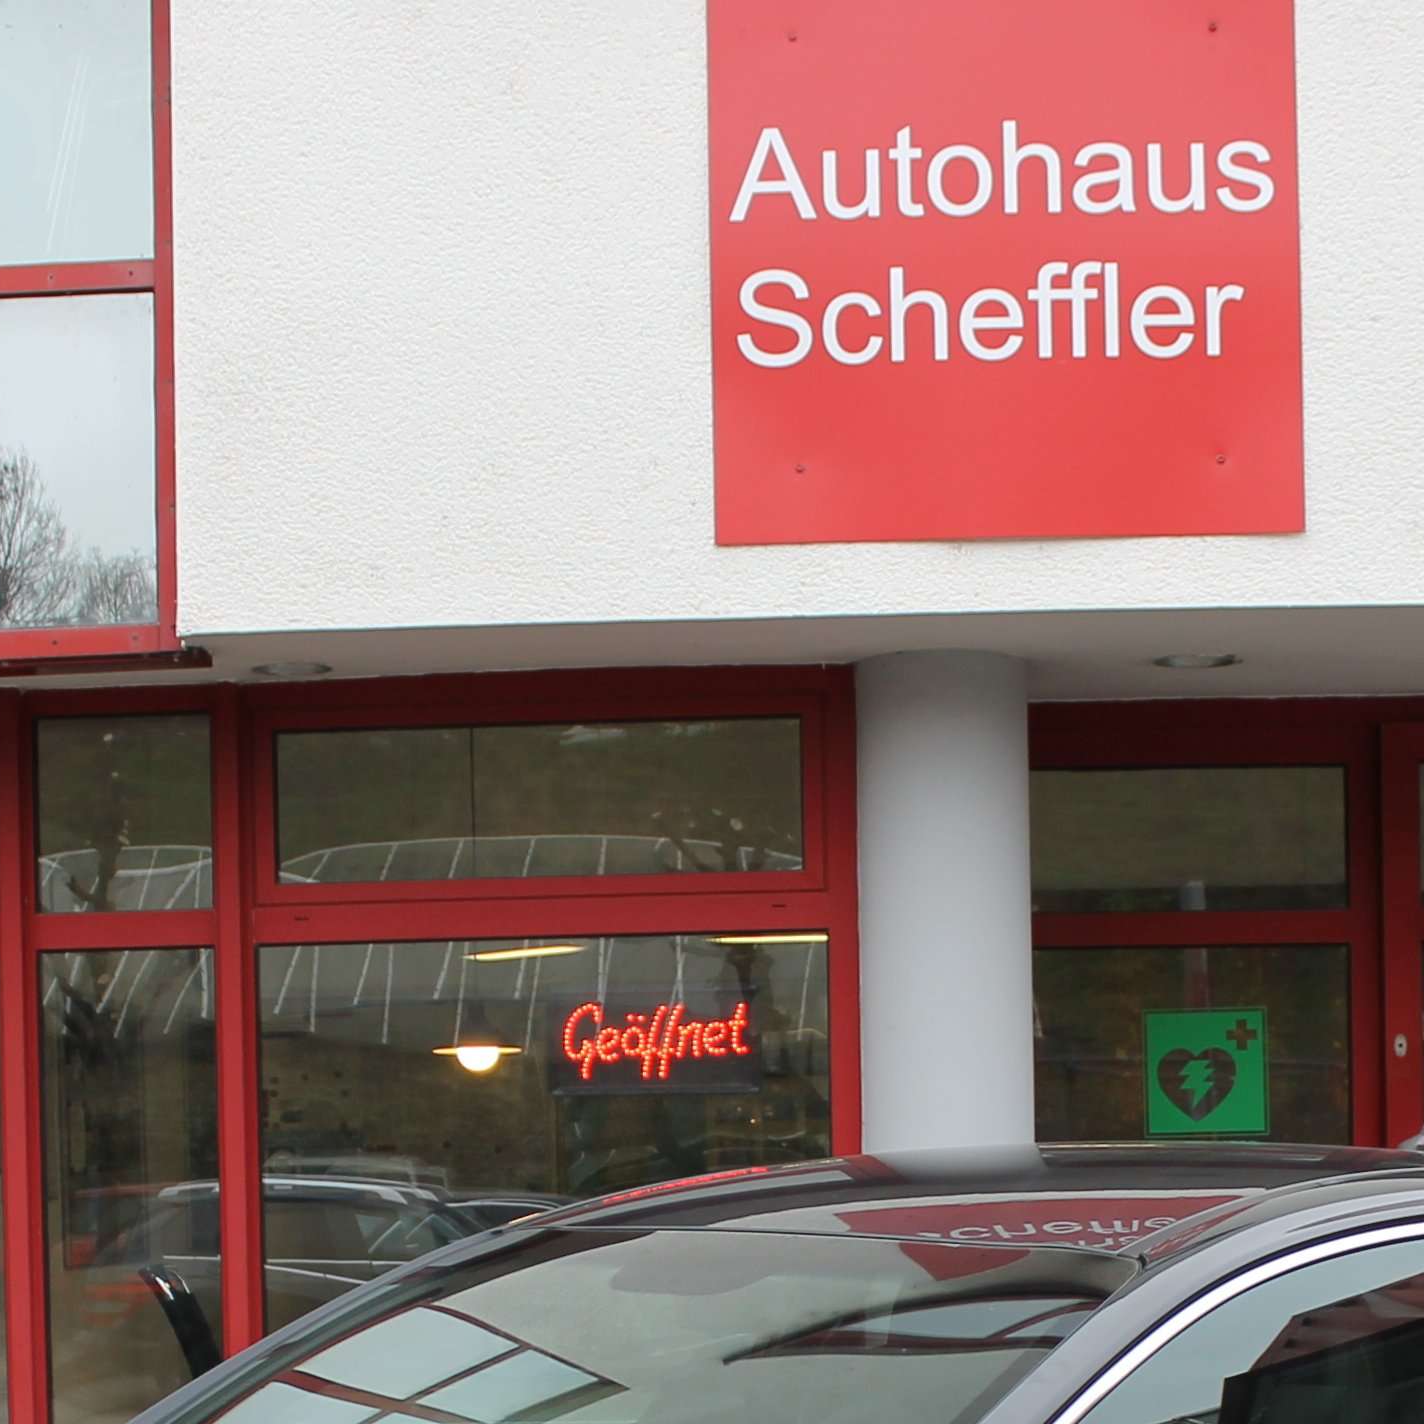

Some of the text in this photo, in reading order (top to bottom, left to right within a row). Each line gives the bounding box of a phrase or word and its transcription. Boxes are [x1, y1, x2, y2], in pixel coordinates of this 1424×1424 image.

[729, 119, 1275, 223] Autohaus
[736, 260, 1245, 368] Scheffler
[563, 1000, 752, 1080] Geöffnet
